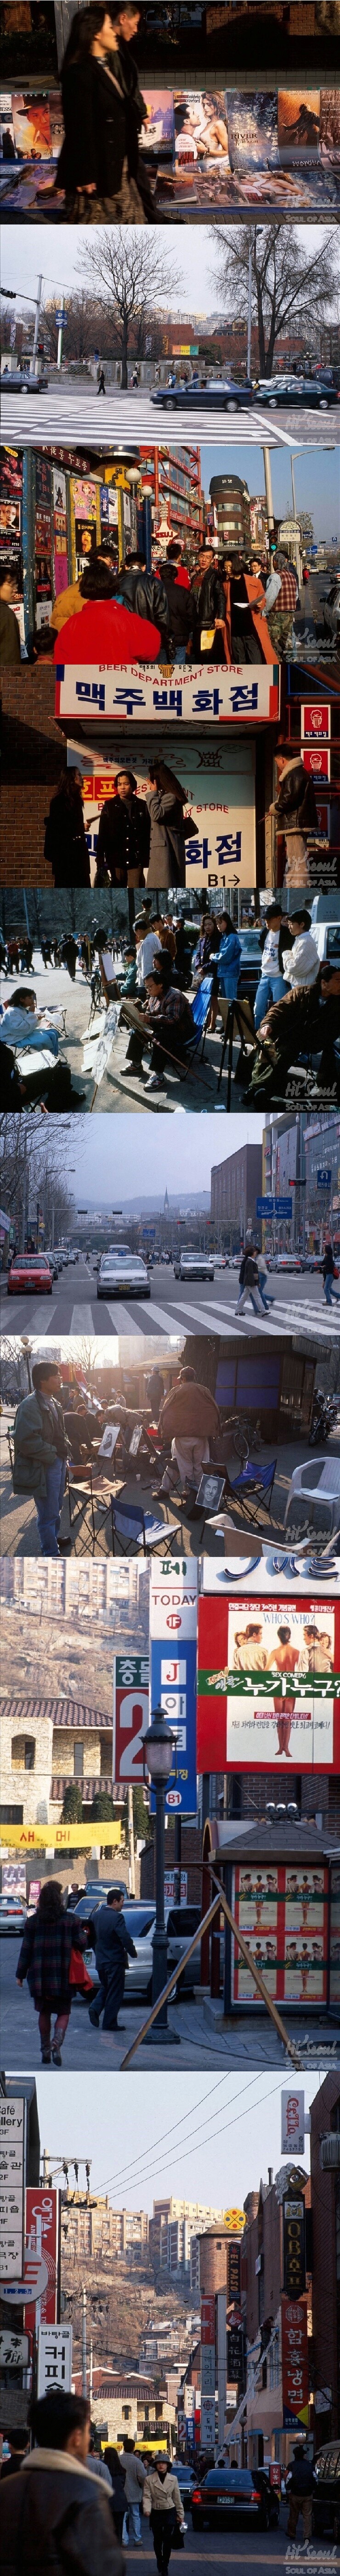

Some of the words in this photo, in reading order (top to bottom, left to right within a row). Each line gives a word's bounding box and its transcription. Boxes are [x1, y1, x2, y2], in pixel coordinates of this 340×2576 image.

[99, 664, 127, 673] BEER
[131, 669, 203, 686] DEPARTMENT
[207, 664, 243, 675] STORE
[75, 681, 259, 717] 맥주백화점
[196, 803, 229, 814] STORE
[208, 874, 226, 887] B1
[152, 1595, 197, 1605] TODAY
[167, 1617, 180, 1627] 1F
[242, 1678, 340, 1697] 누가누구?
[168, 1794, 180, 1803] B1
[230, 2254, 238, 2264] EL
[41, 2331, 70, 2339] 바탕골
[284, 2328, 305, 2404] 함흥냉면
